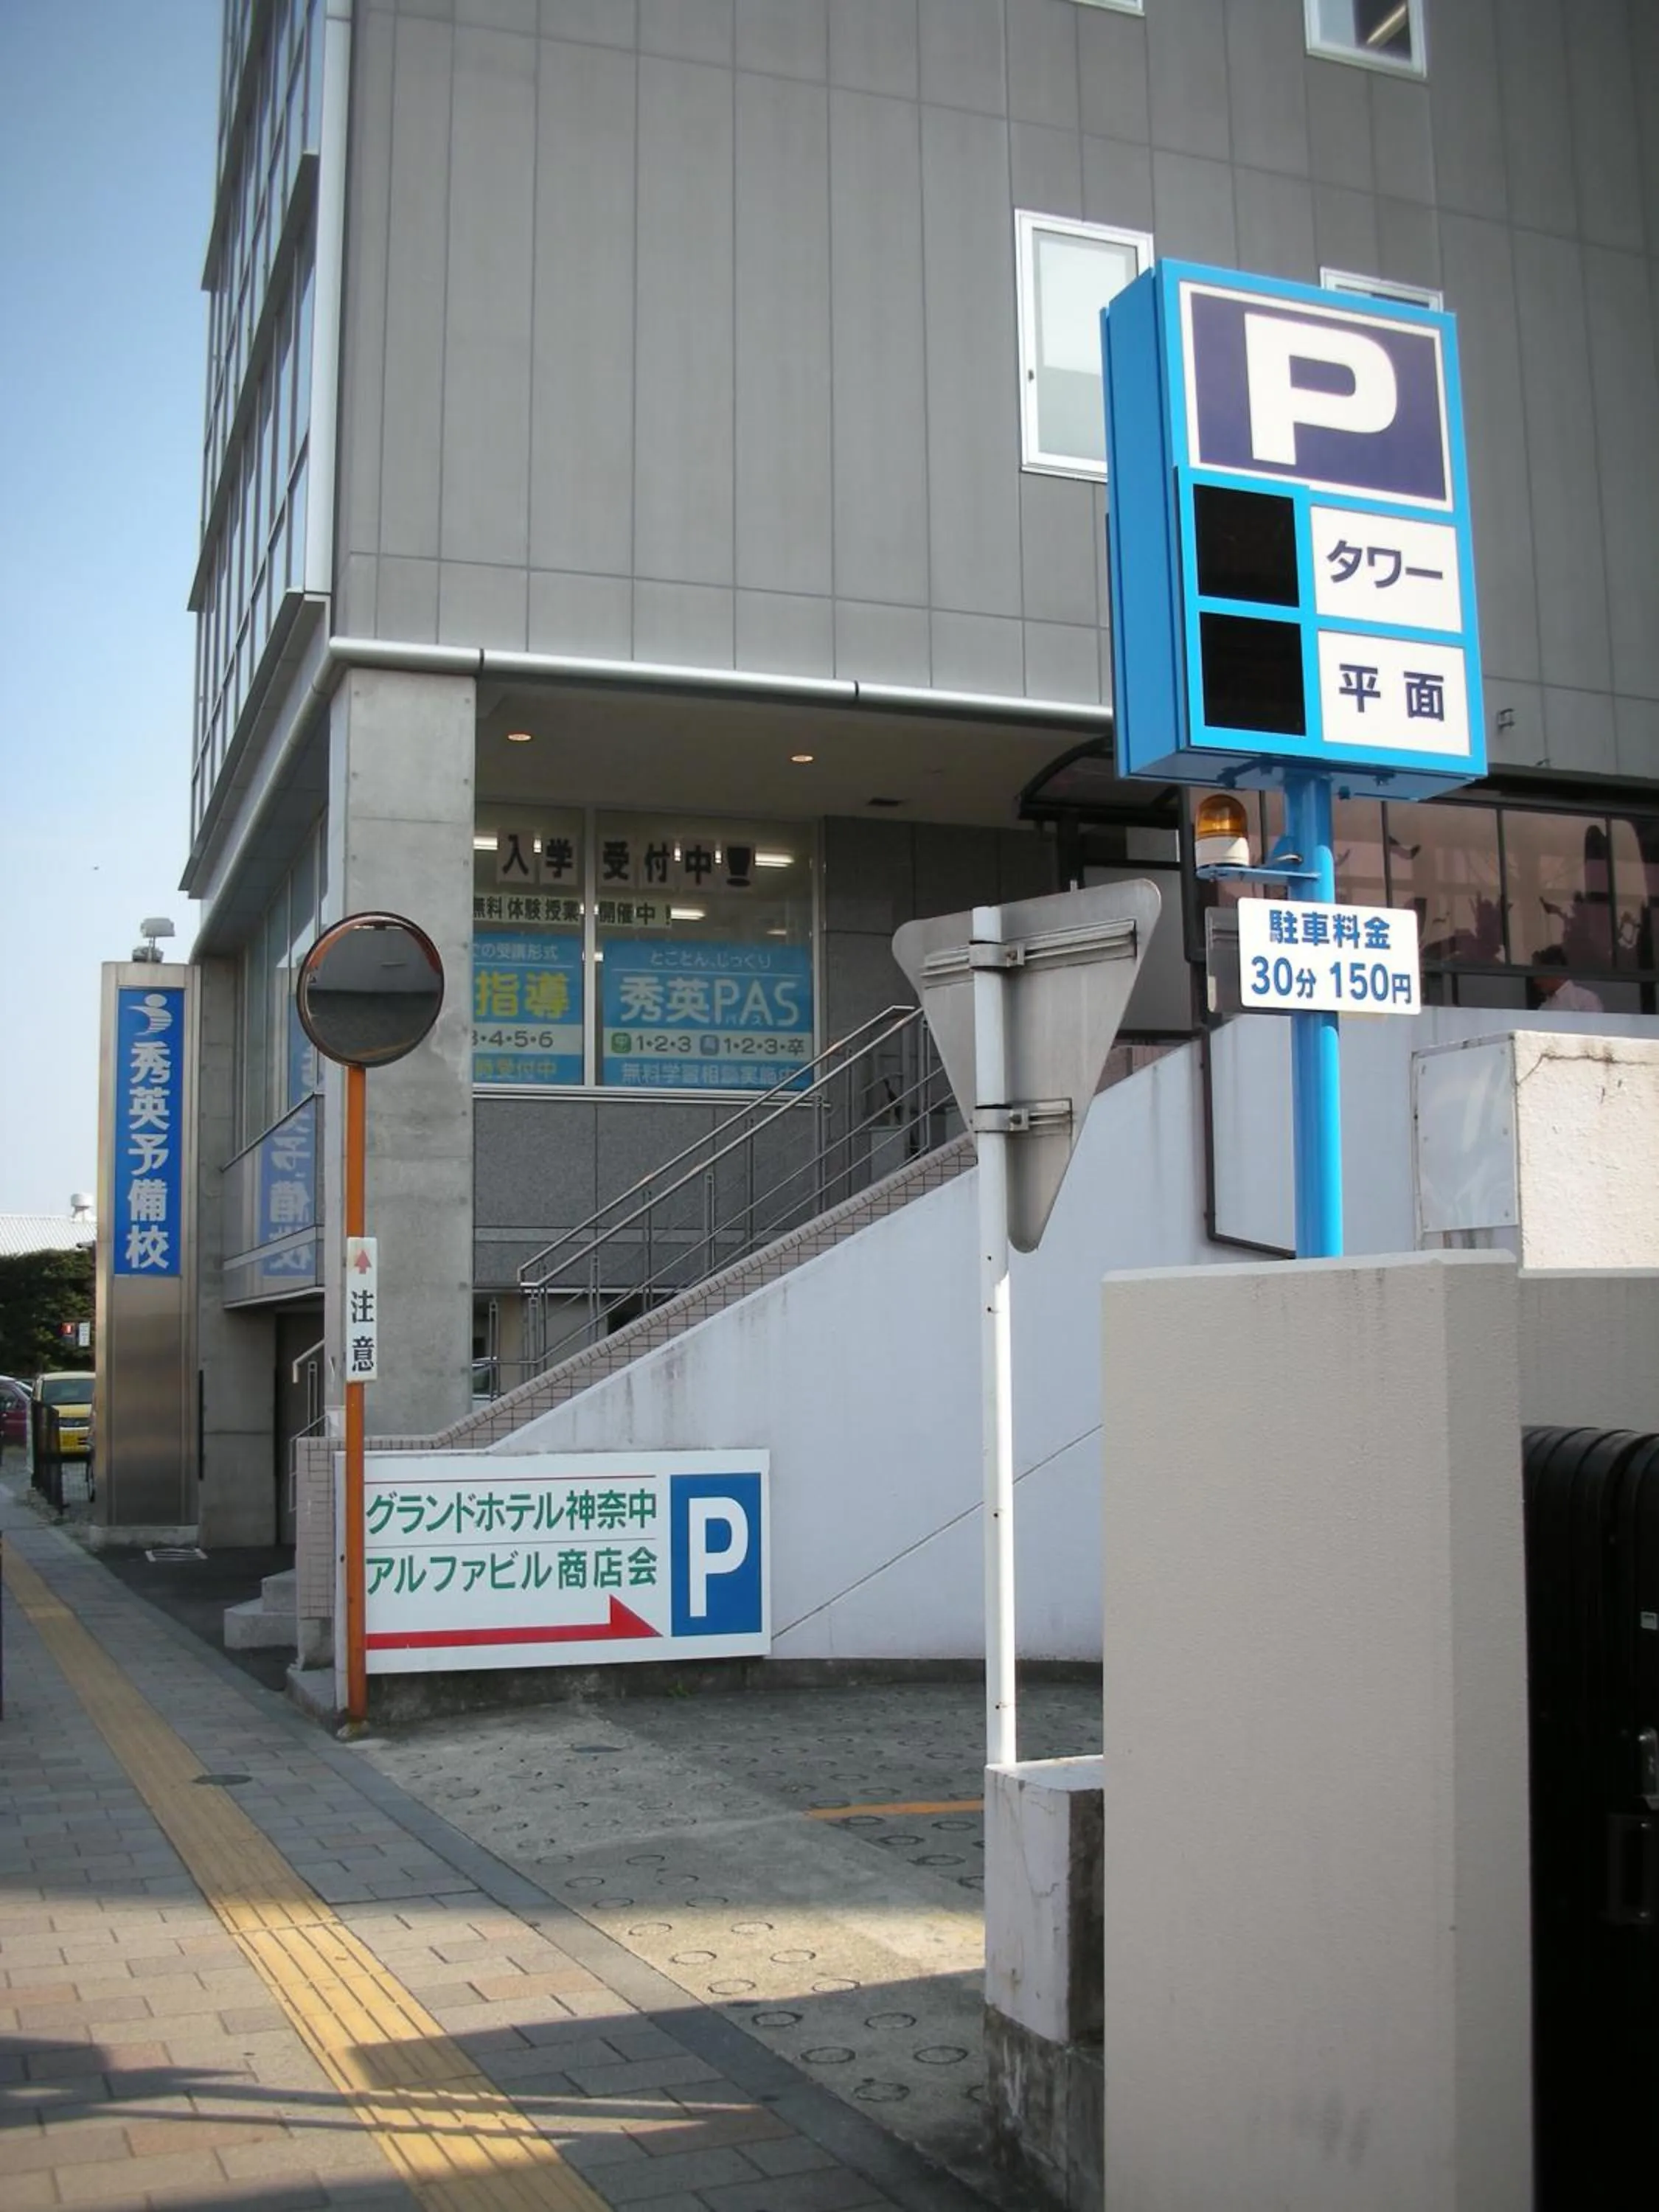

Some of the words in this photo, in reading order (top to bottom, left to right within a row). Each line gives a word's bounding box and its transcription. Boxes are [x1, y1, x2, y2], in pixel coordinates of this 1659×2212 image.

[1245, 312, 1398, 465] P
[1326, 540, 1444, 588] タワー
[1338, 663, 1445, 722] 平面
[1269, 909, 1391, 950] 駐車料金
[476, 970, 570, 1020] 指導
[619, 972, 799, 1026] 秀英PAS
[1251, 955, 1317, 998] 30分
[1329, 961, 1411, 1004] 150円
[125, 1040, 173, 1270] 秀英予備校
[351, 1289, 376, 1372] 注意
[366, 1488, 658, 1534] グランドホテル神奈中
[366, 1545, 658, 1595] アルファビル商店会
[688, 1497, 748, 1617] P
